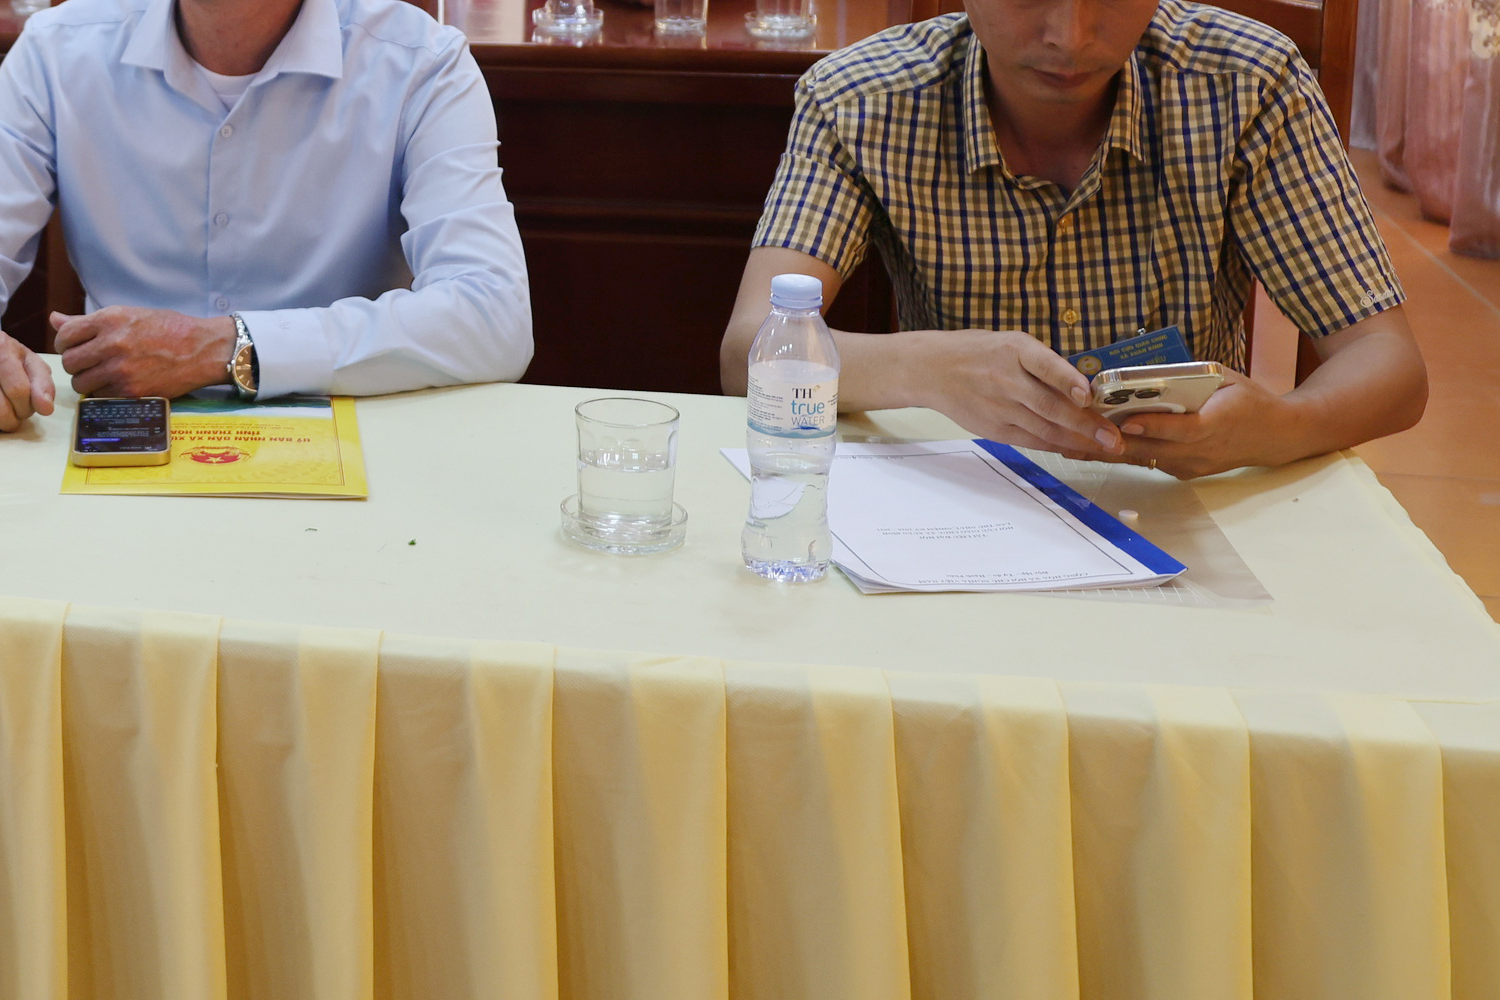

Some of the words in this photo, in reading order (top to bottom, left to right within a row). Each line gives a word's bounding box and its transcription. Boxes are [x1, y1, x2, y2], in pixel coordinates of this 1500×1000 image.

[792, 388, 812, 399] TH
[791, 400, 825, 415] true
[791, 416, 825, 425] WATER
